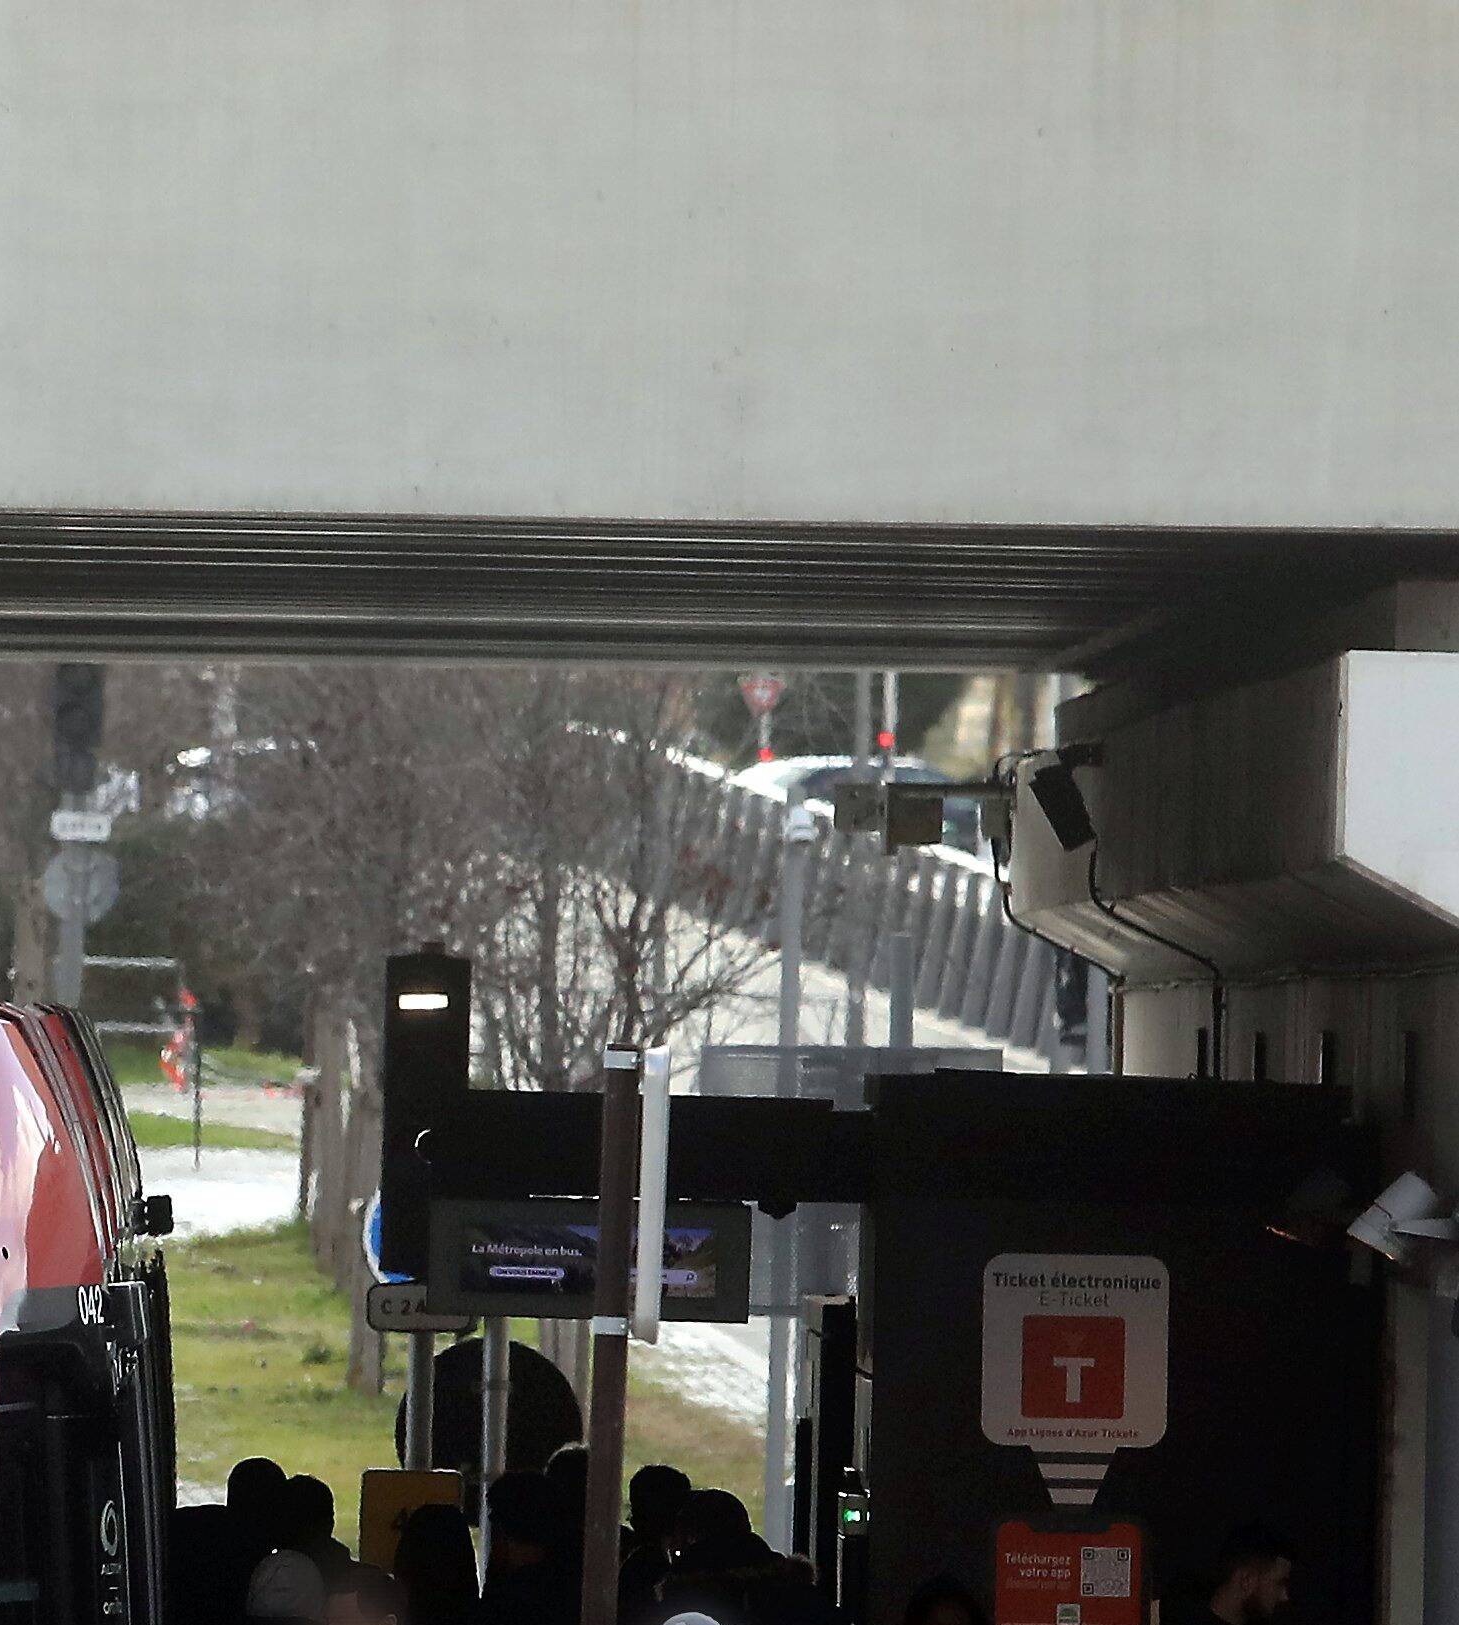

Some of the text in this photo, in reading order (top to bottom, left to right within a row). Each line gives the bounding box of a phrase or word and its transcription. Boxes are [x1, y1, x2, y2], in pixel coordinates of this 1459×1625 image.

[472, 1243, 485, 1254] La
[486, 1243, 543, 1258] Métropole
[544, 1247, 559, 1256] en
[992, 1271, 1163, 1292] Ticket électronique
[78, 1284, 105, 1325] 042
[1039, 1292, 1110, 1308] E-Ticket
[1053, 1357, 1096, 1403] T
[1007, 1428, 1139, 1440] App Lignes d'Azur Tickets
[1004, 1552, 1071, 1566] Téléchargez
[1019, 1567, 1071, 1580] votre app
